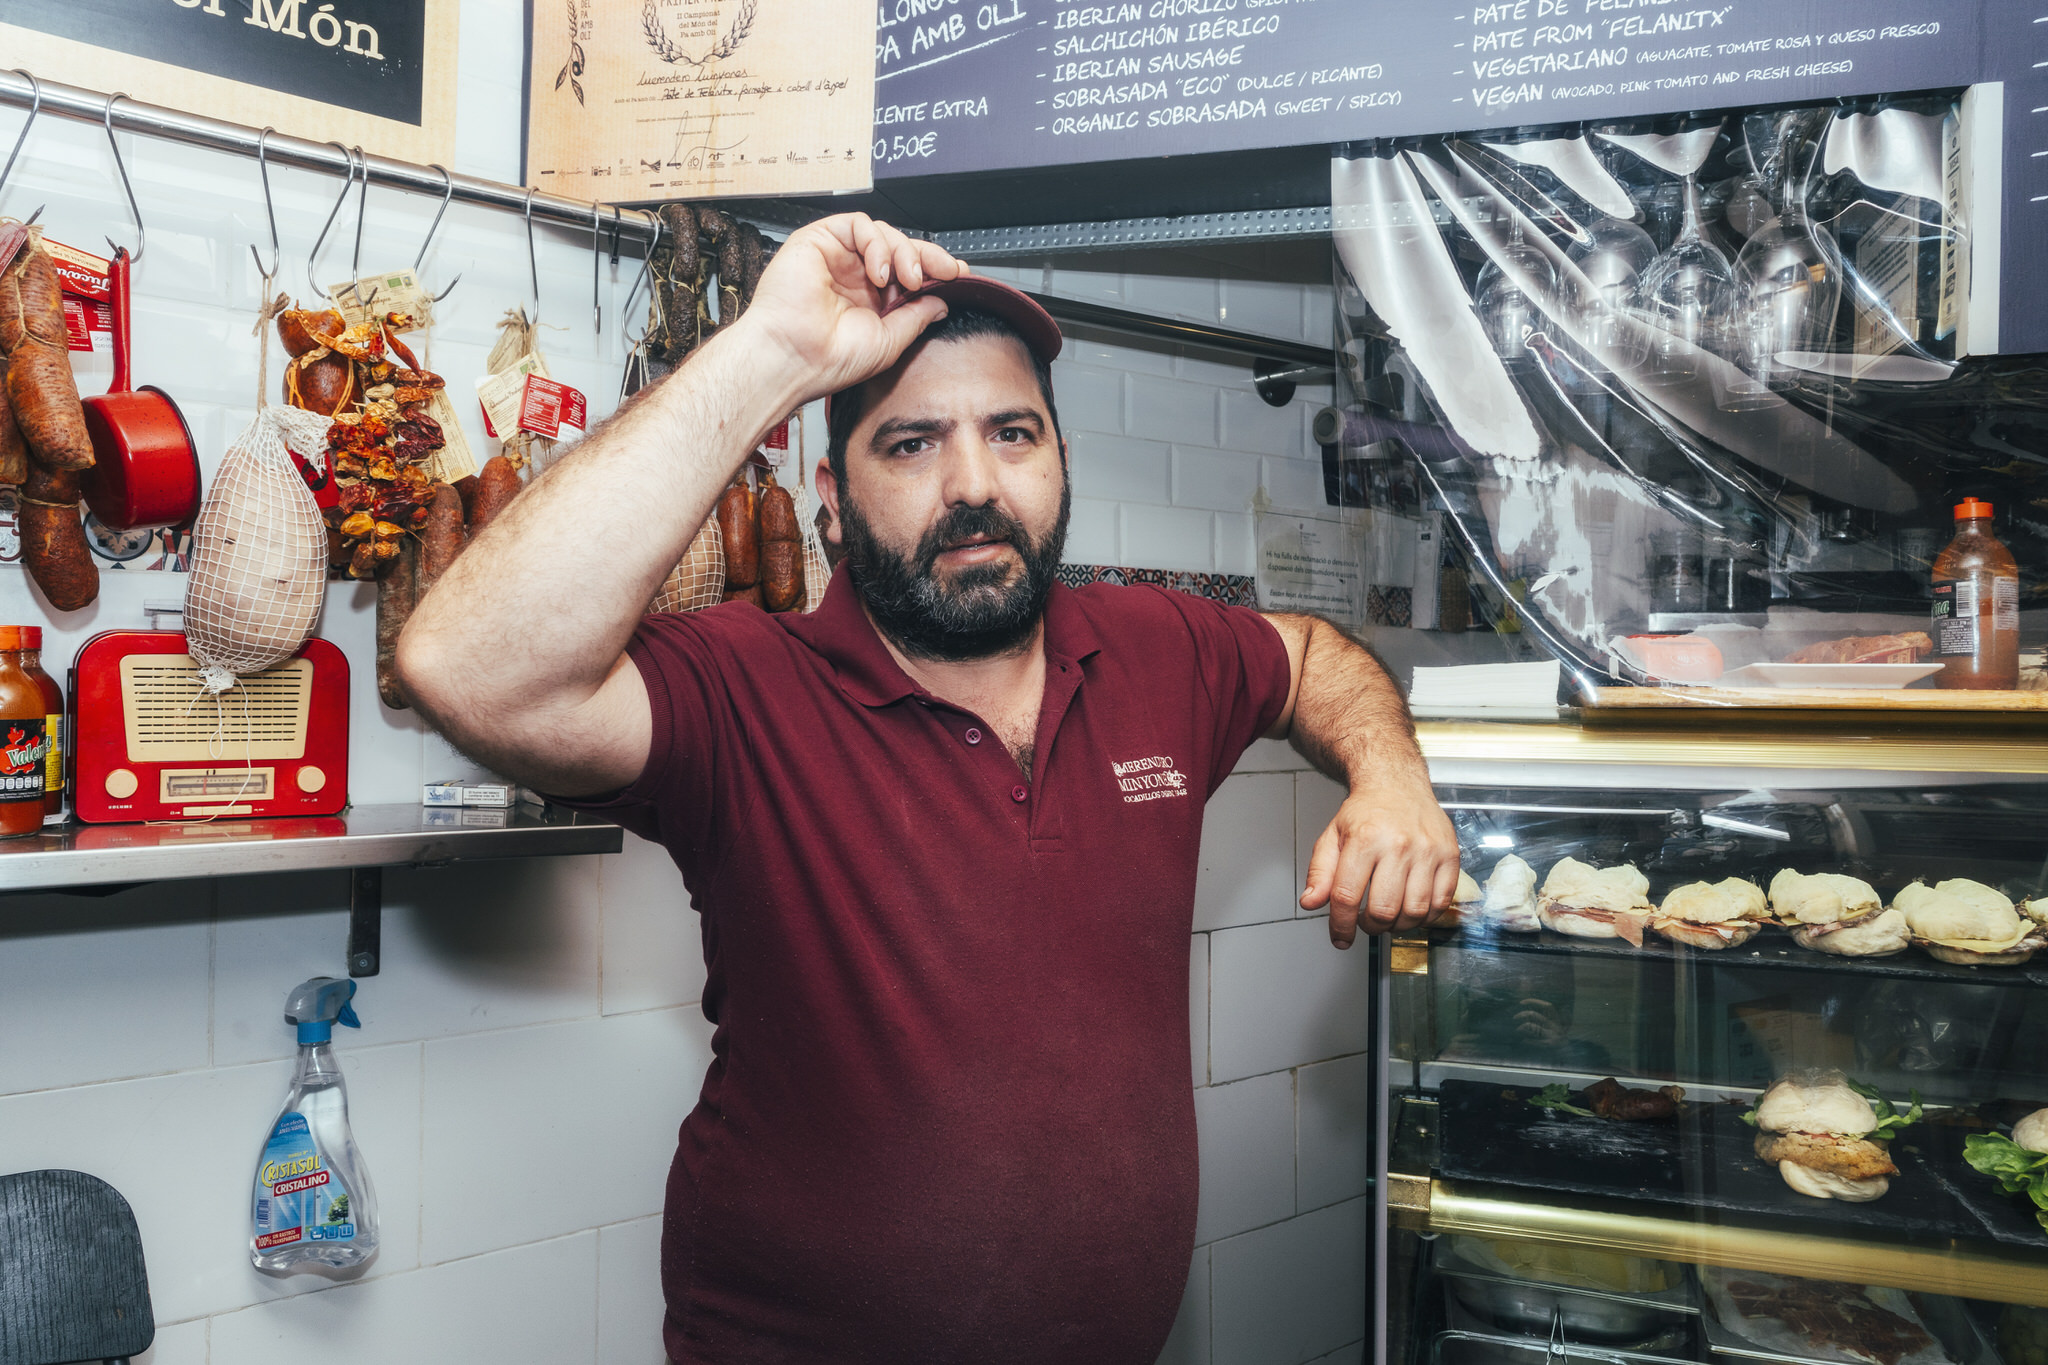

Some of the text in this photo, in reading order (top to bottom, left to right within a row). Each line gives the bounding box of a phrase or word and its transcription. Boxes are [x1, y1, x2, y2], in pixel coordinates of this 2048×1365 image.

[684, 10, 721, 20] Campionat
[911, 14, 966, 54] AMB
[977, 0, 1027, 31] OLI
[1054, 4, 1142, 30] IBERIAN
[1537, 0, 1570, 18] DE
[243, 0, 384, 60] Món
[1054, 14, 1280, 57] SALCHICHÓN IBÉRICO
[1473, 28, 1528, 52] PATE
[1533, 23, 1593, 47] FROM
[1052, 44, 1245, 83] IBERIAN SAUSAGE
[1472, 47, 1628, 80] VEGETARIANO
[1717, 38, 1772, 56] TOMATE
[1776, 36, 1811, 50] ROSA
[1816, 34, 1824, 46] Y
[1829, 28, 1875, 46] QUESO
[1880, 21, 1940, 40] FRESCO)
[1052, 82, 1168, 110] SOBRASADA
[1237, 72, 1296, 92] (DULCE
[1311, 63, 1383, 85] PICANTE)
[1472, 83, 1543, 107] VEGAN
[1620, 80, 1652, 94] PINK
[1654, 74, 1708, 90] TOMATO
[1712, 71, 1740, 85] AND
[1745, 66, 1790, 82] FRESH
[1795, 59, 1853, 78] CHEESE)
[932, 97, 988, 119] EXTRA
[1052, 111, 1139, 136] ORGANIC
[1146, 98, 1267, 128] SOBRASADA
[1274, 97, 1332, 117] (SWEET
[1349, 90, 1402, 110] SPICY)
[261, 1155, 321, 1188] CRISTASOL
[275, 1173, 327, 1195] CRISTALINO
